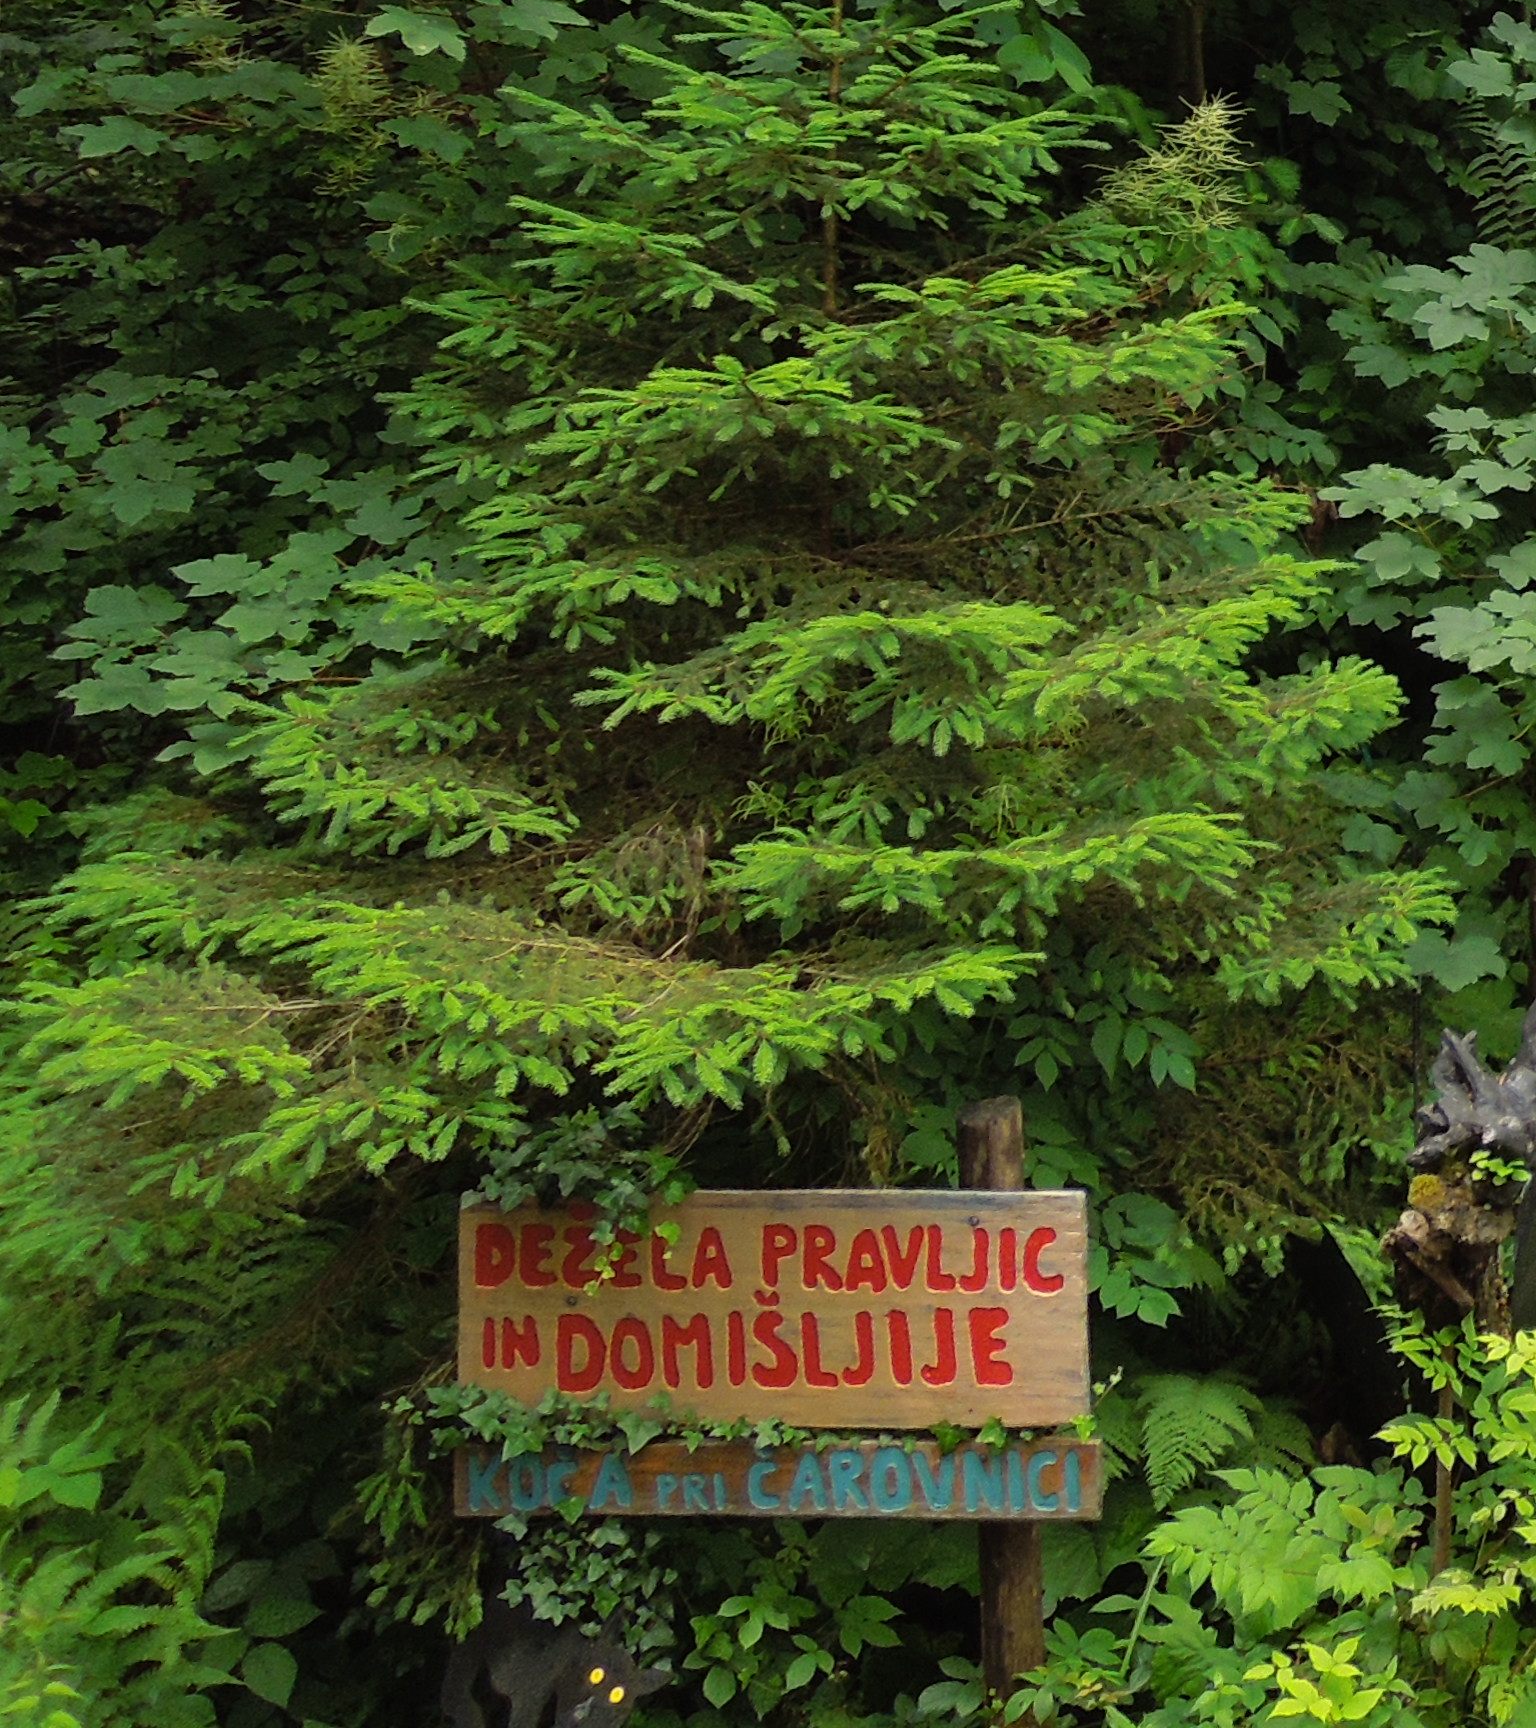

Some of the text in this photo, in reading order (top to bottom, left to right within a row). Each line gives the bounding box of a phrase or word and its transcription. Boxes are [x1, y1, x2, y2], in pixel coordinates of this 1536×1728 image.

[474, 1203, 1066, 1295] DEŽELA PRAVLJIC
[482, 1290, 1015, 1393] IN DOMIŠLJIJE
[468, 1446, 1081, 1513] KOČA PRI ČAROVNICI
